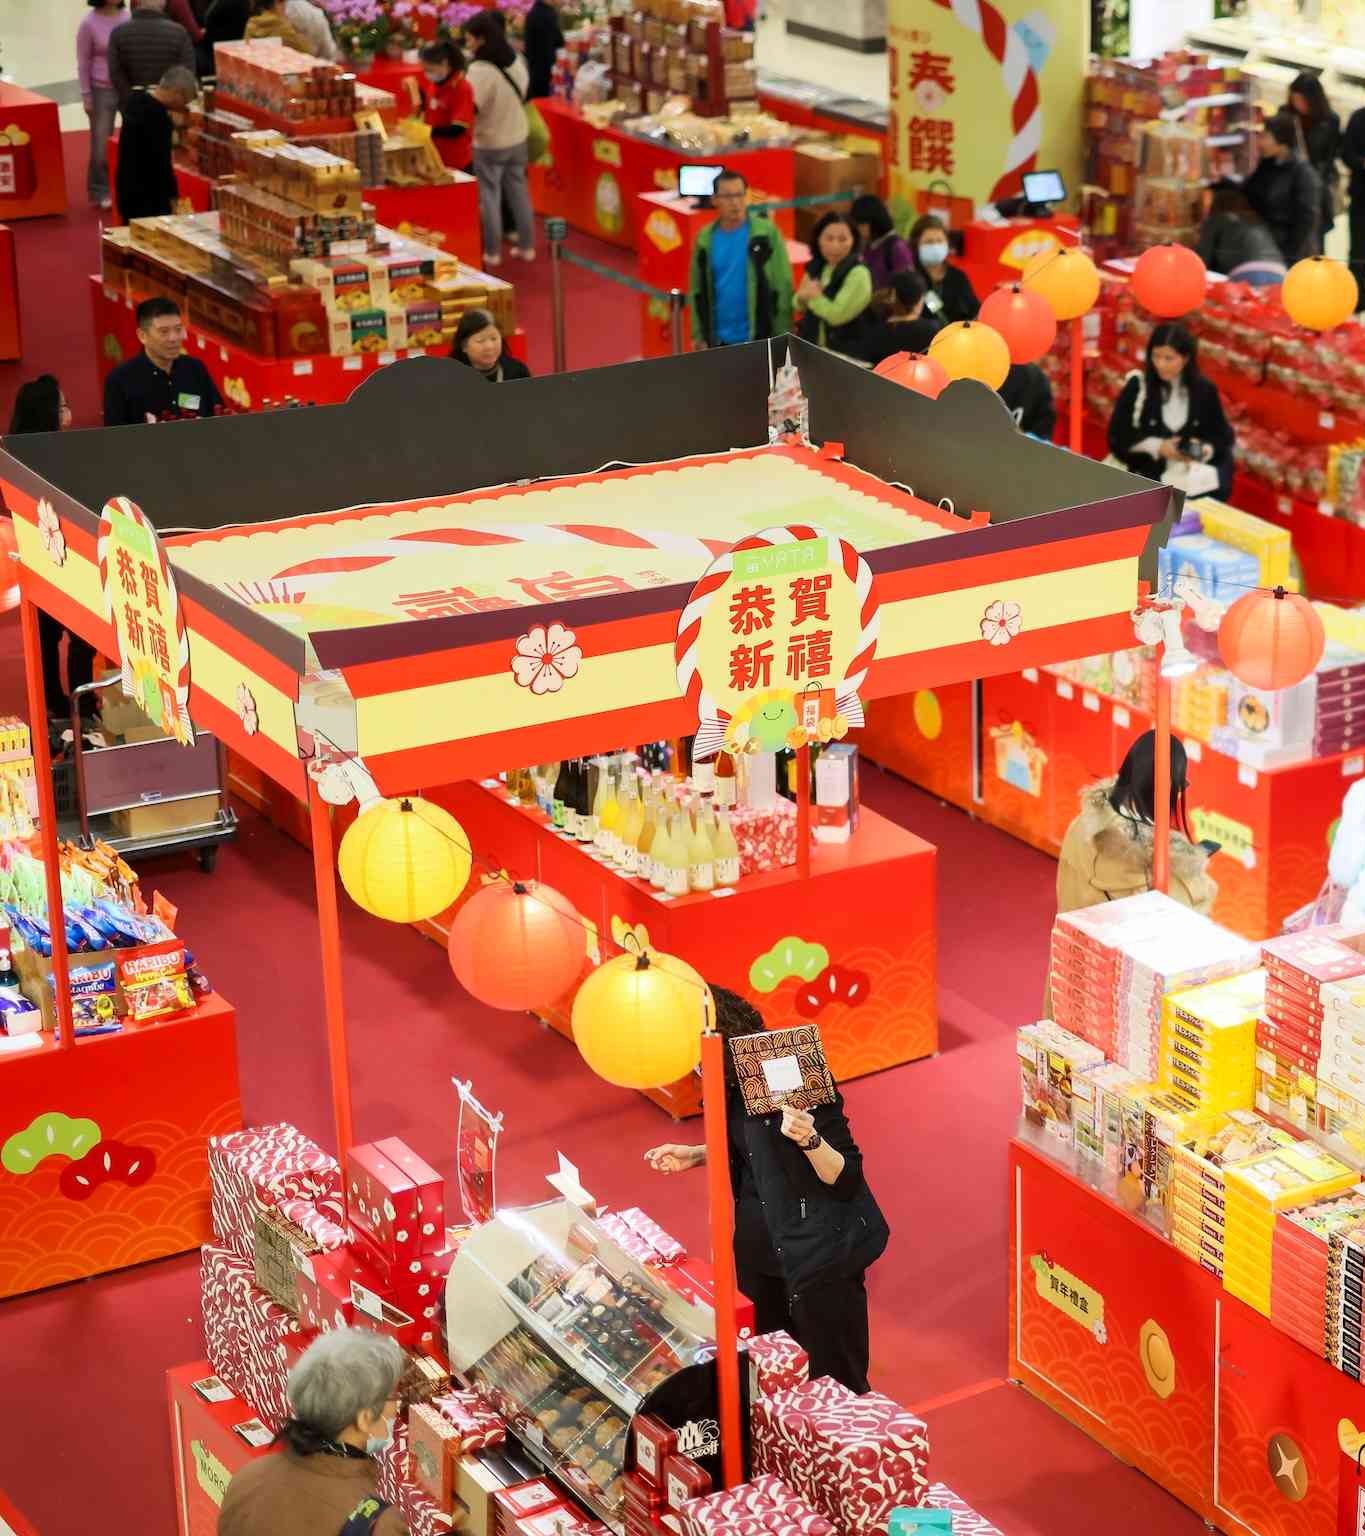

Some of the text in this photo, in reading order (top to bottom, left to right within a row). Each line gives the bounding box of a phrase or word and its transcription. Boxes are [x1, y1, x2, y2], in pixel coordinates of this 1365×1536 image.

[115, 545, 162, 616] 恭賀
[728, 573, 832, 636] 恭賀
[123, 601, 171, 674] 新禧
[728, 629, 832, 692] 新禧
[69, 967, 112, 985] ARIBO
[124, 950, 181, 976] HARIBO
[1049, 1273, 1089, 1315] 賀年禮盒
